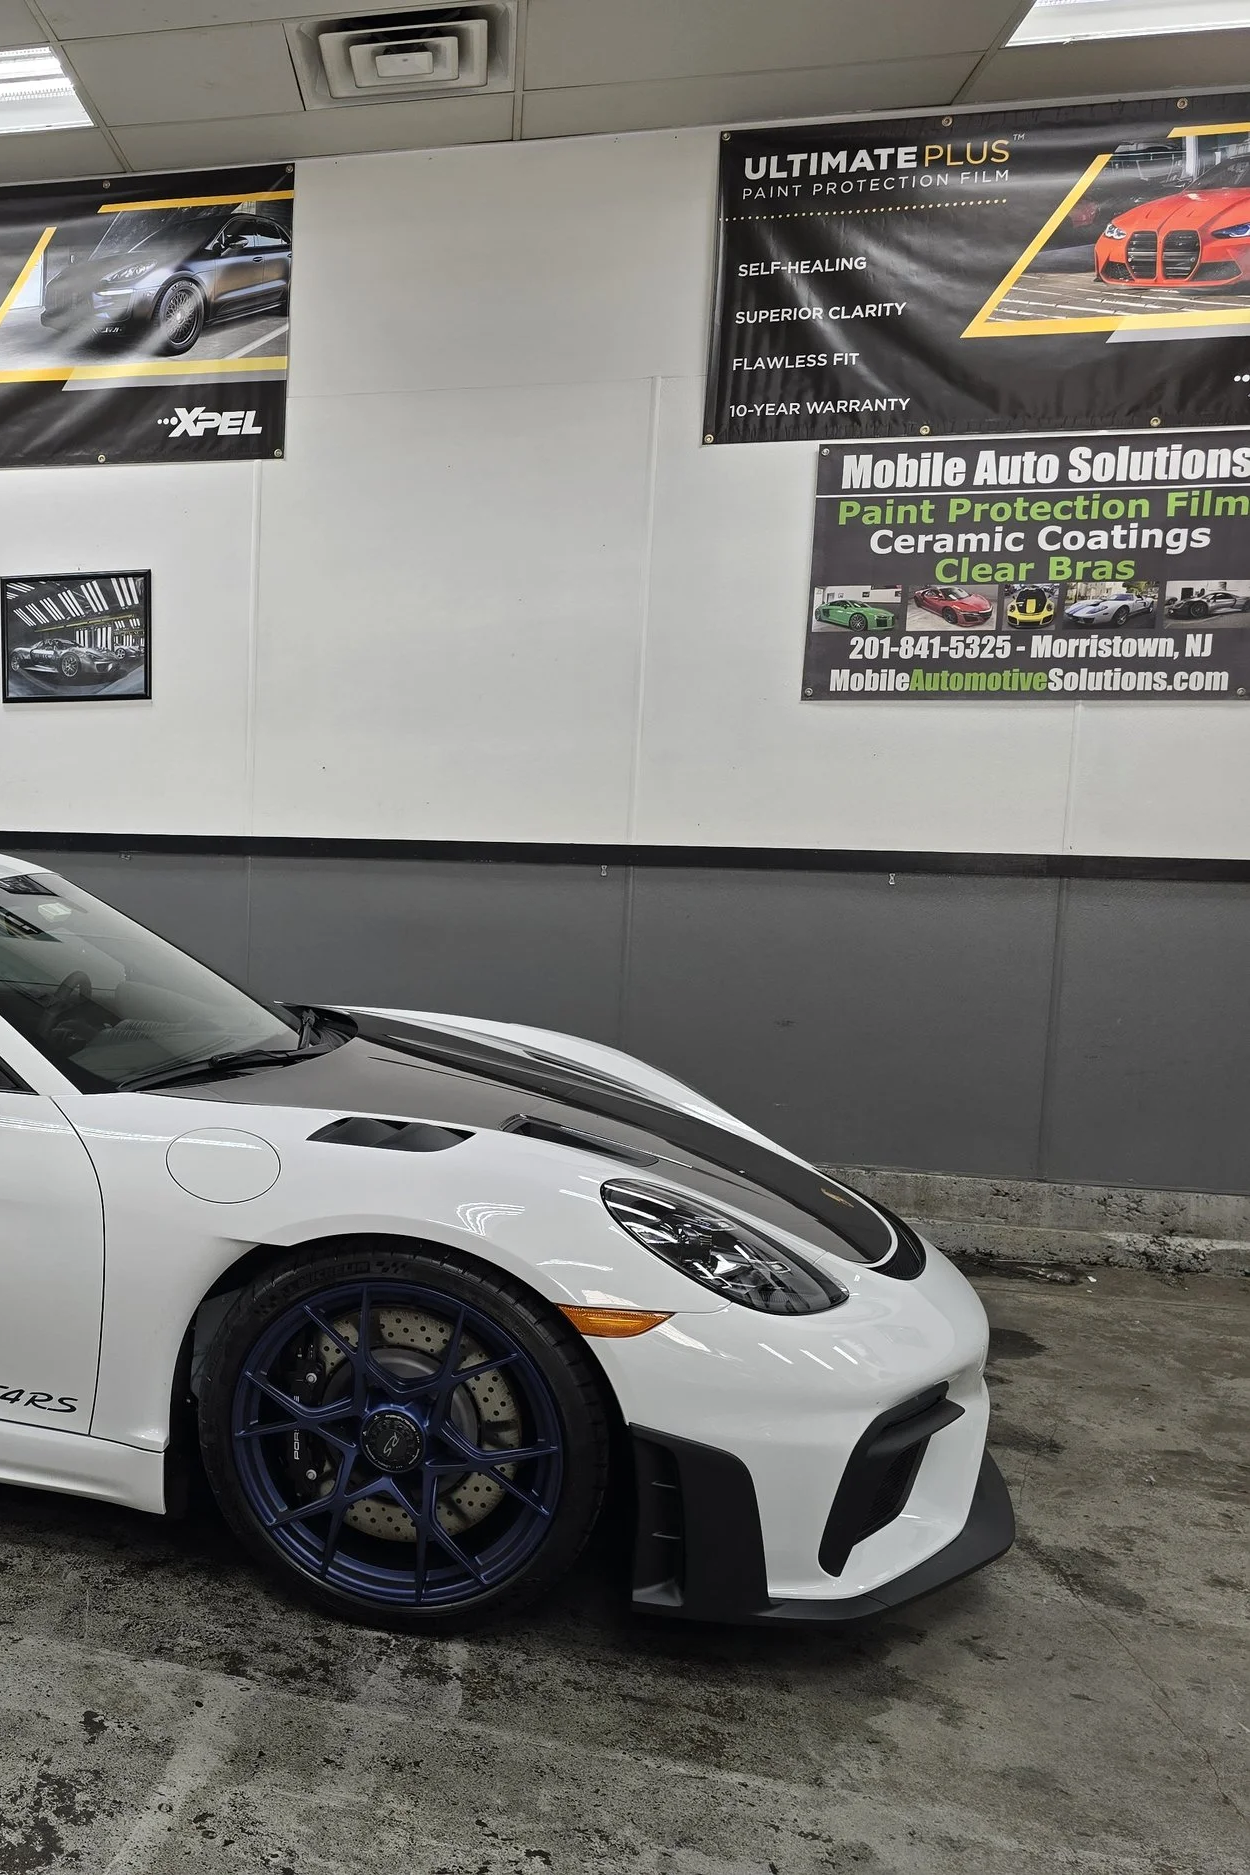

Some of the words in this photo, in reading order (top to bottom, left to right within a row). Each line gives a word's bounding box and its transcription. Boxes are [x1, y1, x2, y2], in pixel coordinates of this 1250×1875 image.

[742, 185, 803, 200] PAINT
[812, 173, 949, 196] PROTECTION
[960, 169, 1010, 185] FILM
[738, 256, 867, 277] SELF-HEALING
[735, 306, 824, 325] SUPERIOR
[828, 302, 907, 320] CLARITY
[732, 354, 829, 371] FLAWLESS
[833, 352, 860, 367] FIT
[729, 402, 801, 418] 10-YEAR
[806, 398, 911, 416] WARRANTY
[167, 407, 262, 437] XPEL
[841, 452, 966, 490] Mobile
[973, 450, 1059, 486] Auto
[1068, 443, 1250, 483] Solutions
[838, 499, 936, 526] Paint
[948, 493, 1149, 523] Protection
[1166, 490, 1249, 518] Film
[870, 527, 1025, 555] Ceramic
[1037, 523, 1211, 555] Coatings
[934, 558, 1034, 584] Clear
[1048, 556, 1136, 581] Bras
[849, 635, 1011, 660] 201-841-5325
[1030, 634, 1179, 660] Morristown,
[1184, 634, 1213, 657] NJ
[829, 669, 1229, 693] MobileAutomotiveSolutions.com
